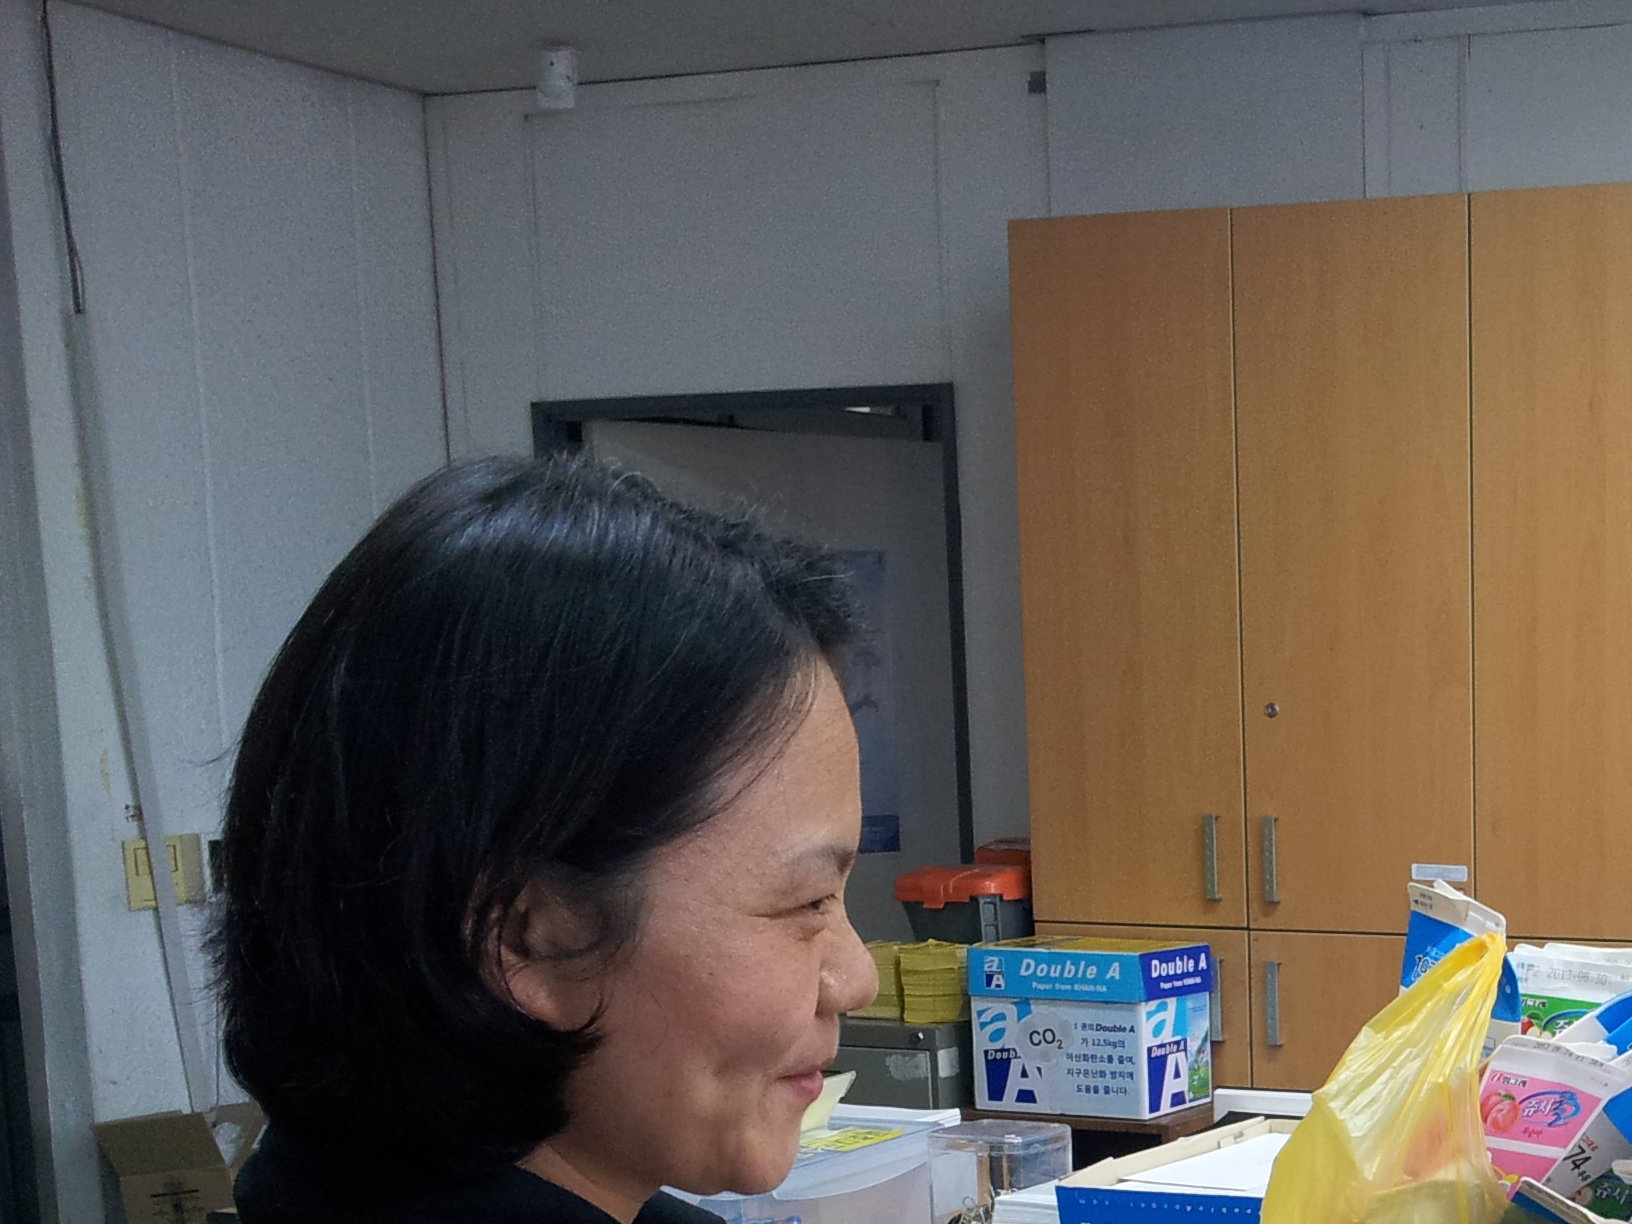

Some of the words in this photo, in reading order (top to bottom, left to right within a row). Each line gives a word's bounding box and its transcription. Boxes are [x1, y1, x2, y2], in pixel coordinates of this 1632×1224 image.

[1019, 958, 1098, 979] Double
[1105, 962, 1121, 980] A
[1150, 956, 1195, 979] Double
[1198, 952, 1208, 971] A
[1032, 982, 1053, 991] Paper
[1054, 983, 1072, 991] from
[1095, 1022, 1128, 1034] Double
[1128, 1024, 1136, 1034] A
[1080, 1037, 1089, 1047] 가
[987, 1049, 1020, 1061] Doub
